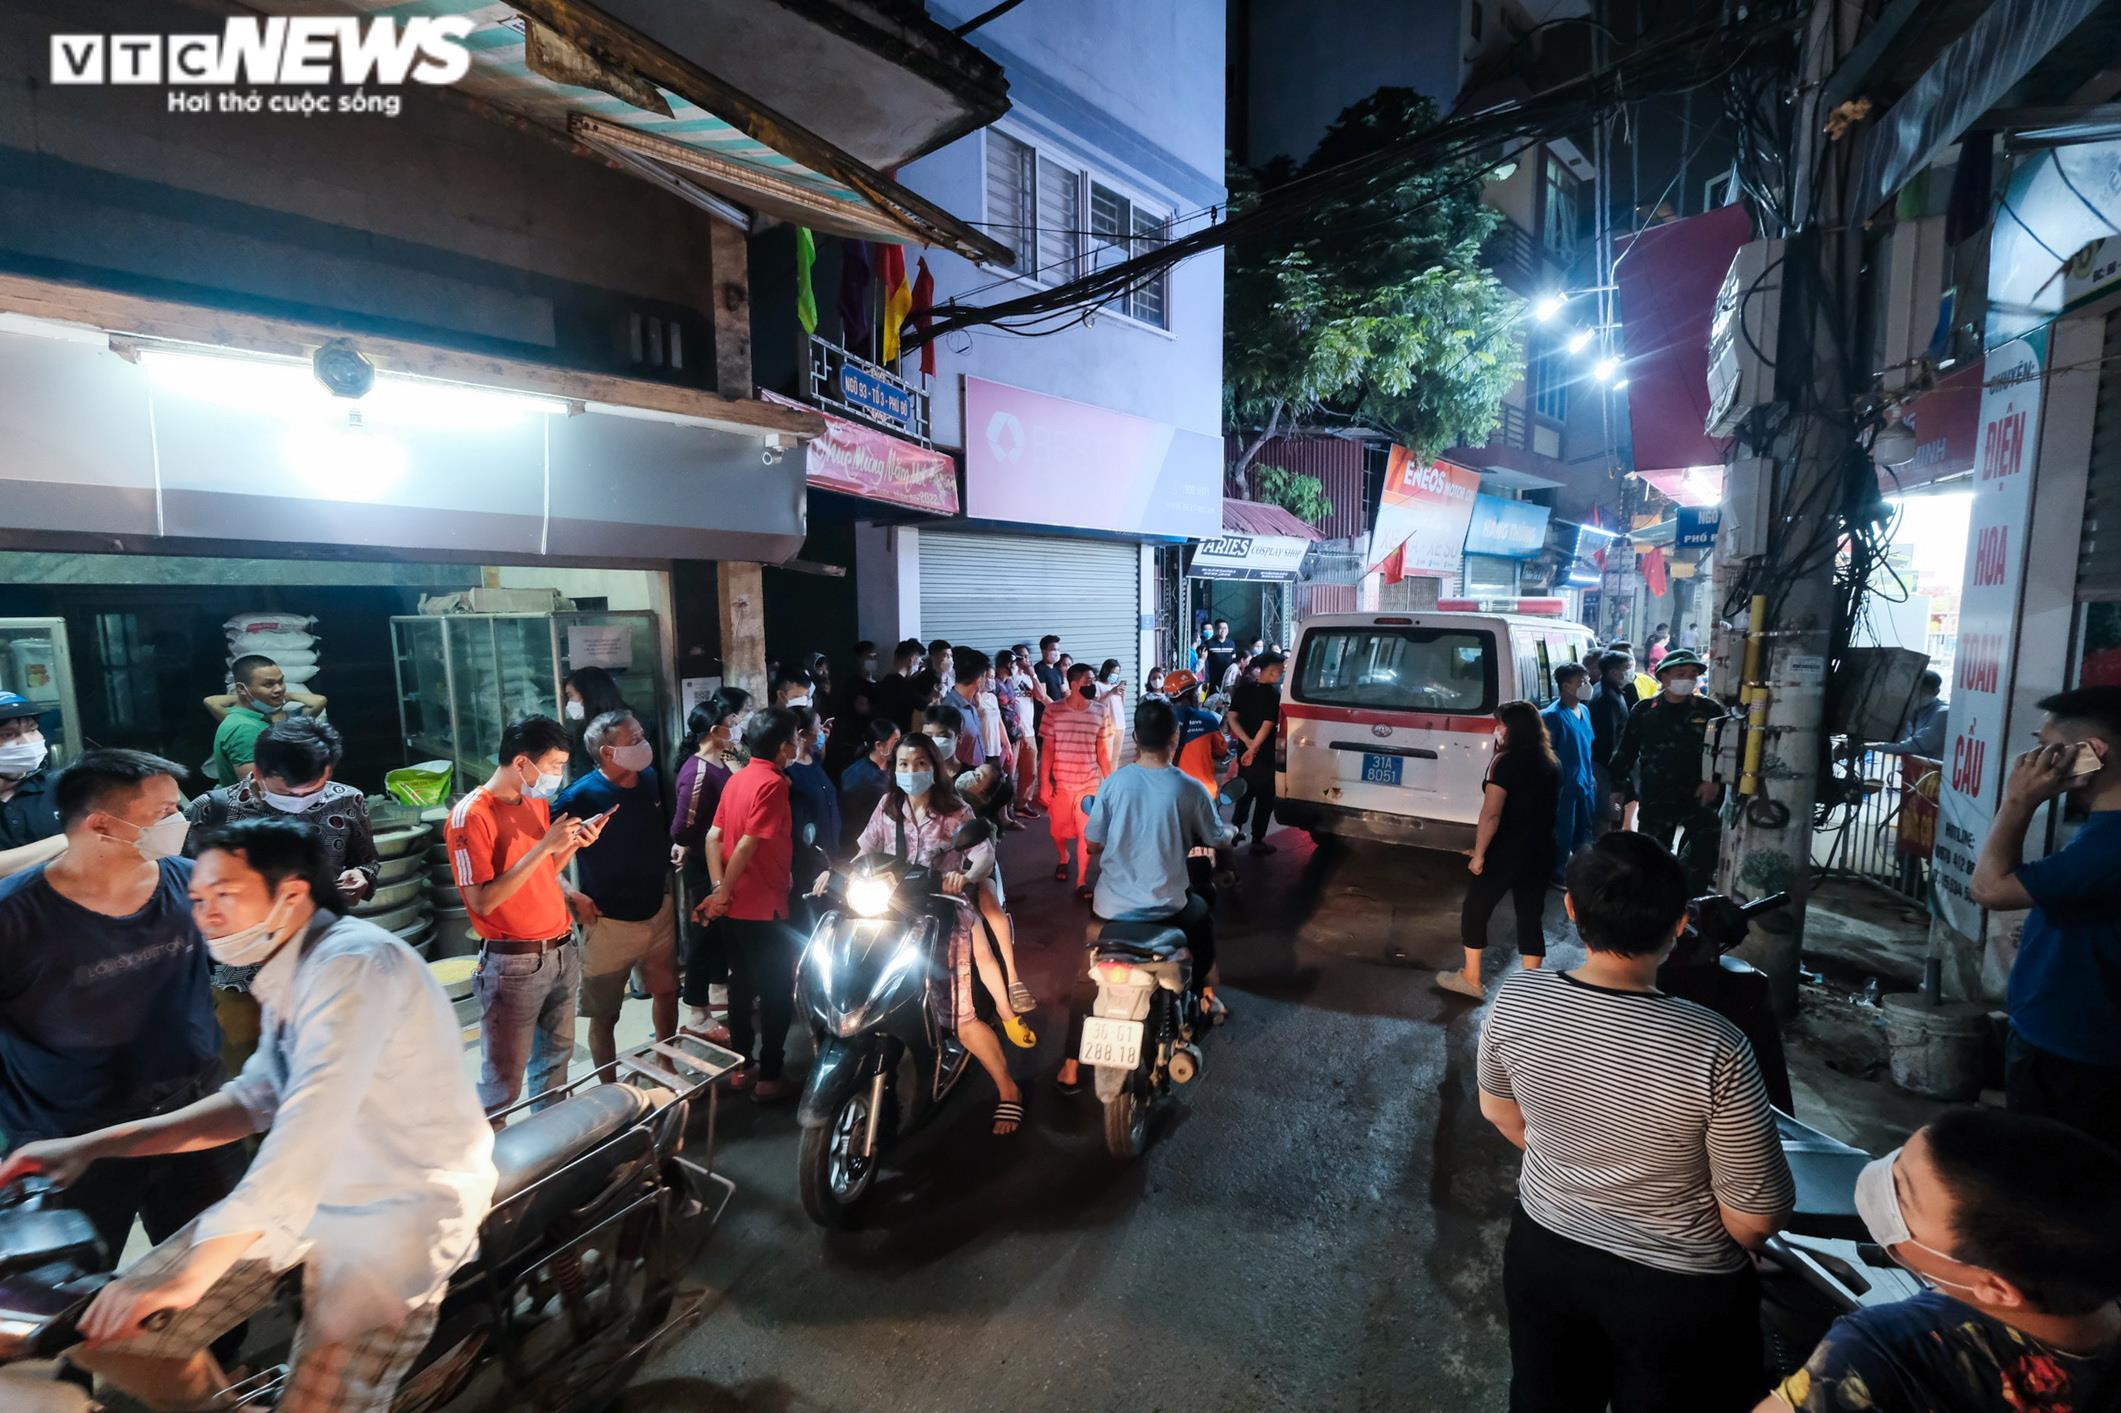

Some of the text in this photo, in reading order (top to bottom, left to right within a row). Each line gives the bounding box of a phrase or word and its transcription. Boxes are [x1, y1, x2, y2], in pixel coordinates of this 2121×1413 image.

[1403, 459, 1446, 494] ENEOS
[1251, 546, 1303, 560] COSPLAY SHOP
[1973, 525, 2009, 587] HOA
[1372, 755, 1392, 769] 31A
[1367, 768, 1396, 783] 8051
[1085, 1041, 1136, 1063] 288.18
